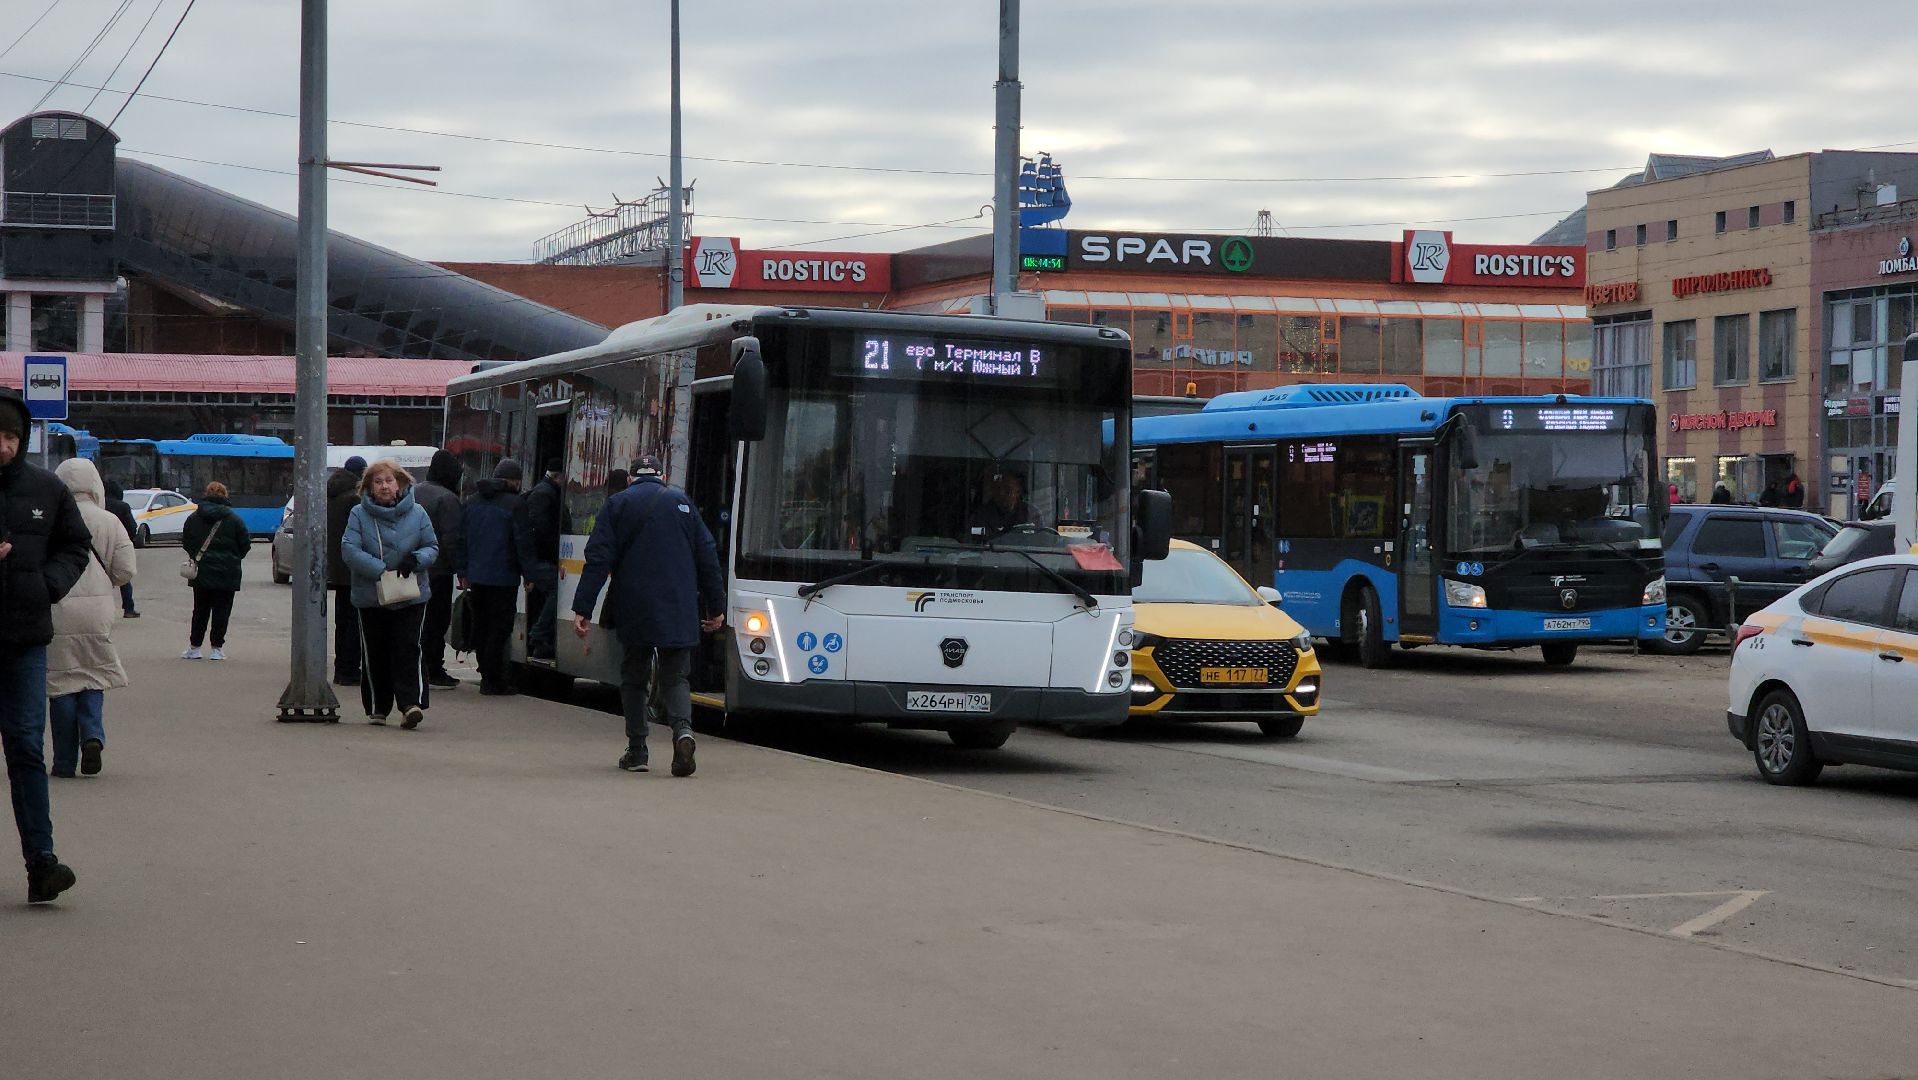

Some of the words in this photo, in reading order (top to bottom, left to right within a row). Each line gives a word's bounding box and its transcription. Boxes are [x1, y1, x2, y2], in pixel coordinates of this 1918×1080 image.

[1081, 236, 1212, 266] SPAR
[763, 259, 867, 282] ROSTIC'S
[1475, 254, 1576, 277] ROSTIC'S
[1878, 257, 1918, 275] ЛОМБА
[864, 340, 890, 370] 21
[905, 345, 936, 357] ево
[945, 344, 1022, 362] Терминал
[934, 359, 963, 372] м/к
[972, 359, 1021, 375] Южный
[1728, 409, 1776, 431] ДВОРИК
[1227, 669, 1247, 681] 117
[968, 694, 987, 706] 790
